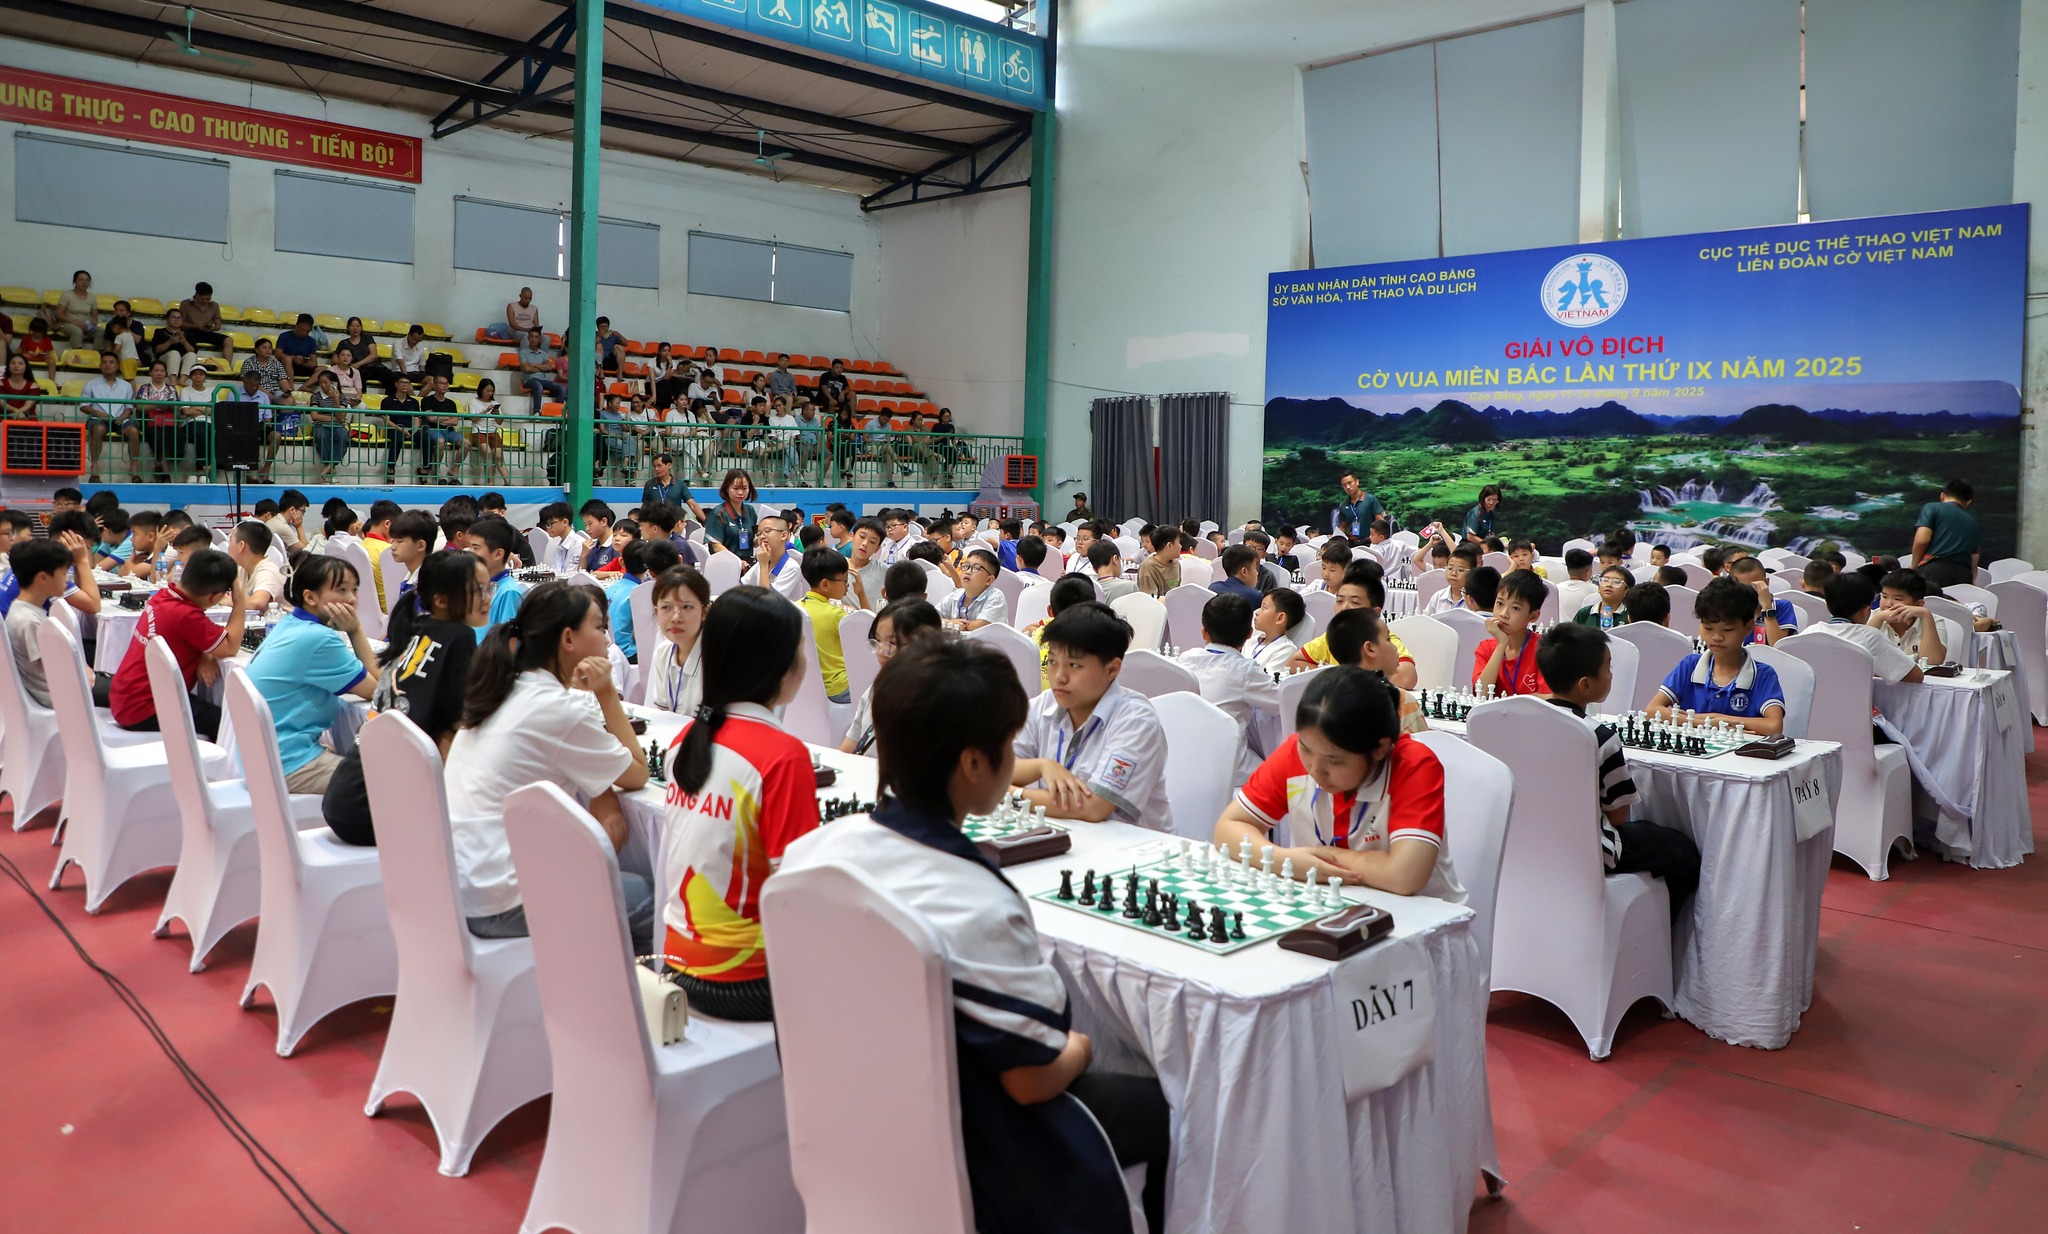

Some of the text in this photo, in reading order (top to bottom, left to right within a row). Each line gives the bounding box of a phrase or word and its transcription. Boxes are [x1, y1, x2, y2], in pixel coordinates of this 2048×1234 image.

[61, 93, 125, 125] THỰC
[150, 108, 195, 134] CAO
[202, 116, 289, 149] THƯỢNG
[310, 132, 355, 160] TIẾN
[361, 142, 394, 168] BỘ!
[1699, 246, 1733, 261] CỤC
[1775, 240, 1811, 255] DỤC
[1855, 232, 1906, 247] THAO
[1911, 228, 1953, 244] VIỆT
[1958, 224, 2002, 239] NAM
[1738, 245, 1954, 273] LIÊN ĐOÀN CỜ VIỆT NAM
[1272, 295, 1289, 307] SỞ
[1291, 293, 1313, 305] VĂN
[1316, 291, 1343, 304] HÓA,
[1372, 287, 1405, 299] THAO
[1408, 284, 1424, 296] VÀ
[1427, 284, 1444, 295] DU
[1448, 282, 1477, 295] LỊCH
[1291, 282, 1315, 293] BAN
[1317, 278, 1349, 291] NHÂN
[1352, 276, 1376, 288] DÂN
[1379, 274, 1406, 286] TỈNH
[1410, 272, 1436, 283] CAO
[1556, 309, 1609, 318] VIETNAM
[1504, 334, 1664, 359] GIẢI VÔ ĐỊCH
[1357, 355, 1862, 389] CỜ VUA MIỀN BẮC LẦN THỨ IX NĂM 2025
[1469, 391, 1491, 400] Cao
[1632, 388, 1640, 397] 9
[1674, 386, 1705, 397] 2025
[1813, 778, 1820, 796] 8
[700, 791, 734, 821] AN
[1351, 979, 1414, 1032] DÃY 7
